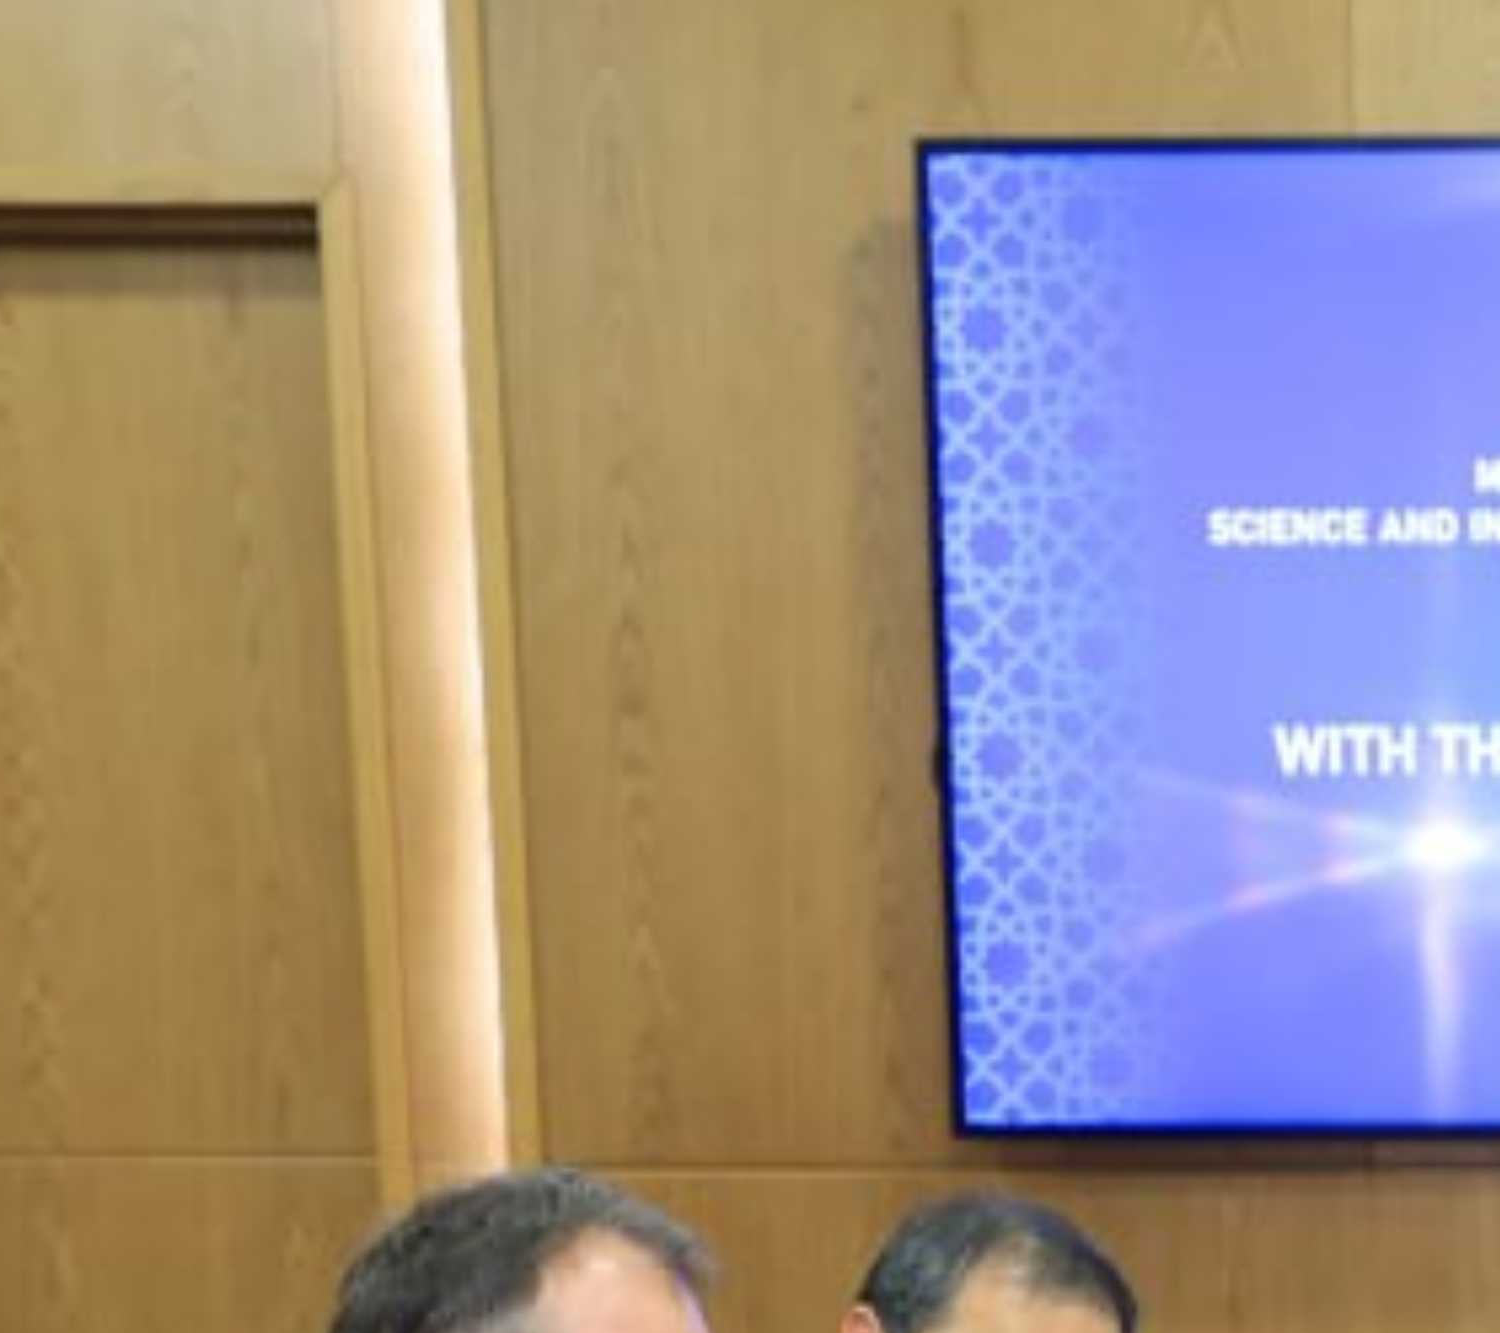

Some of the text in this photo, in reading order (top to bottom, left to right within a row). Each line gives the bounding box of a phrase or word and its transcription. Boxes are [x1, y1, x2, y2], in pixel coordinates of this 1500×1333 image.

[1208, 507, 1369, 544] SCIENCE
[1378, 508, 1459, 543] AND
[1273, 722, 1416, 776] WITH
